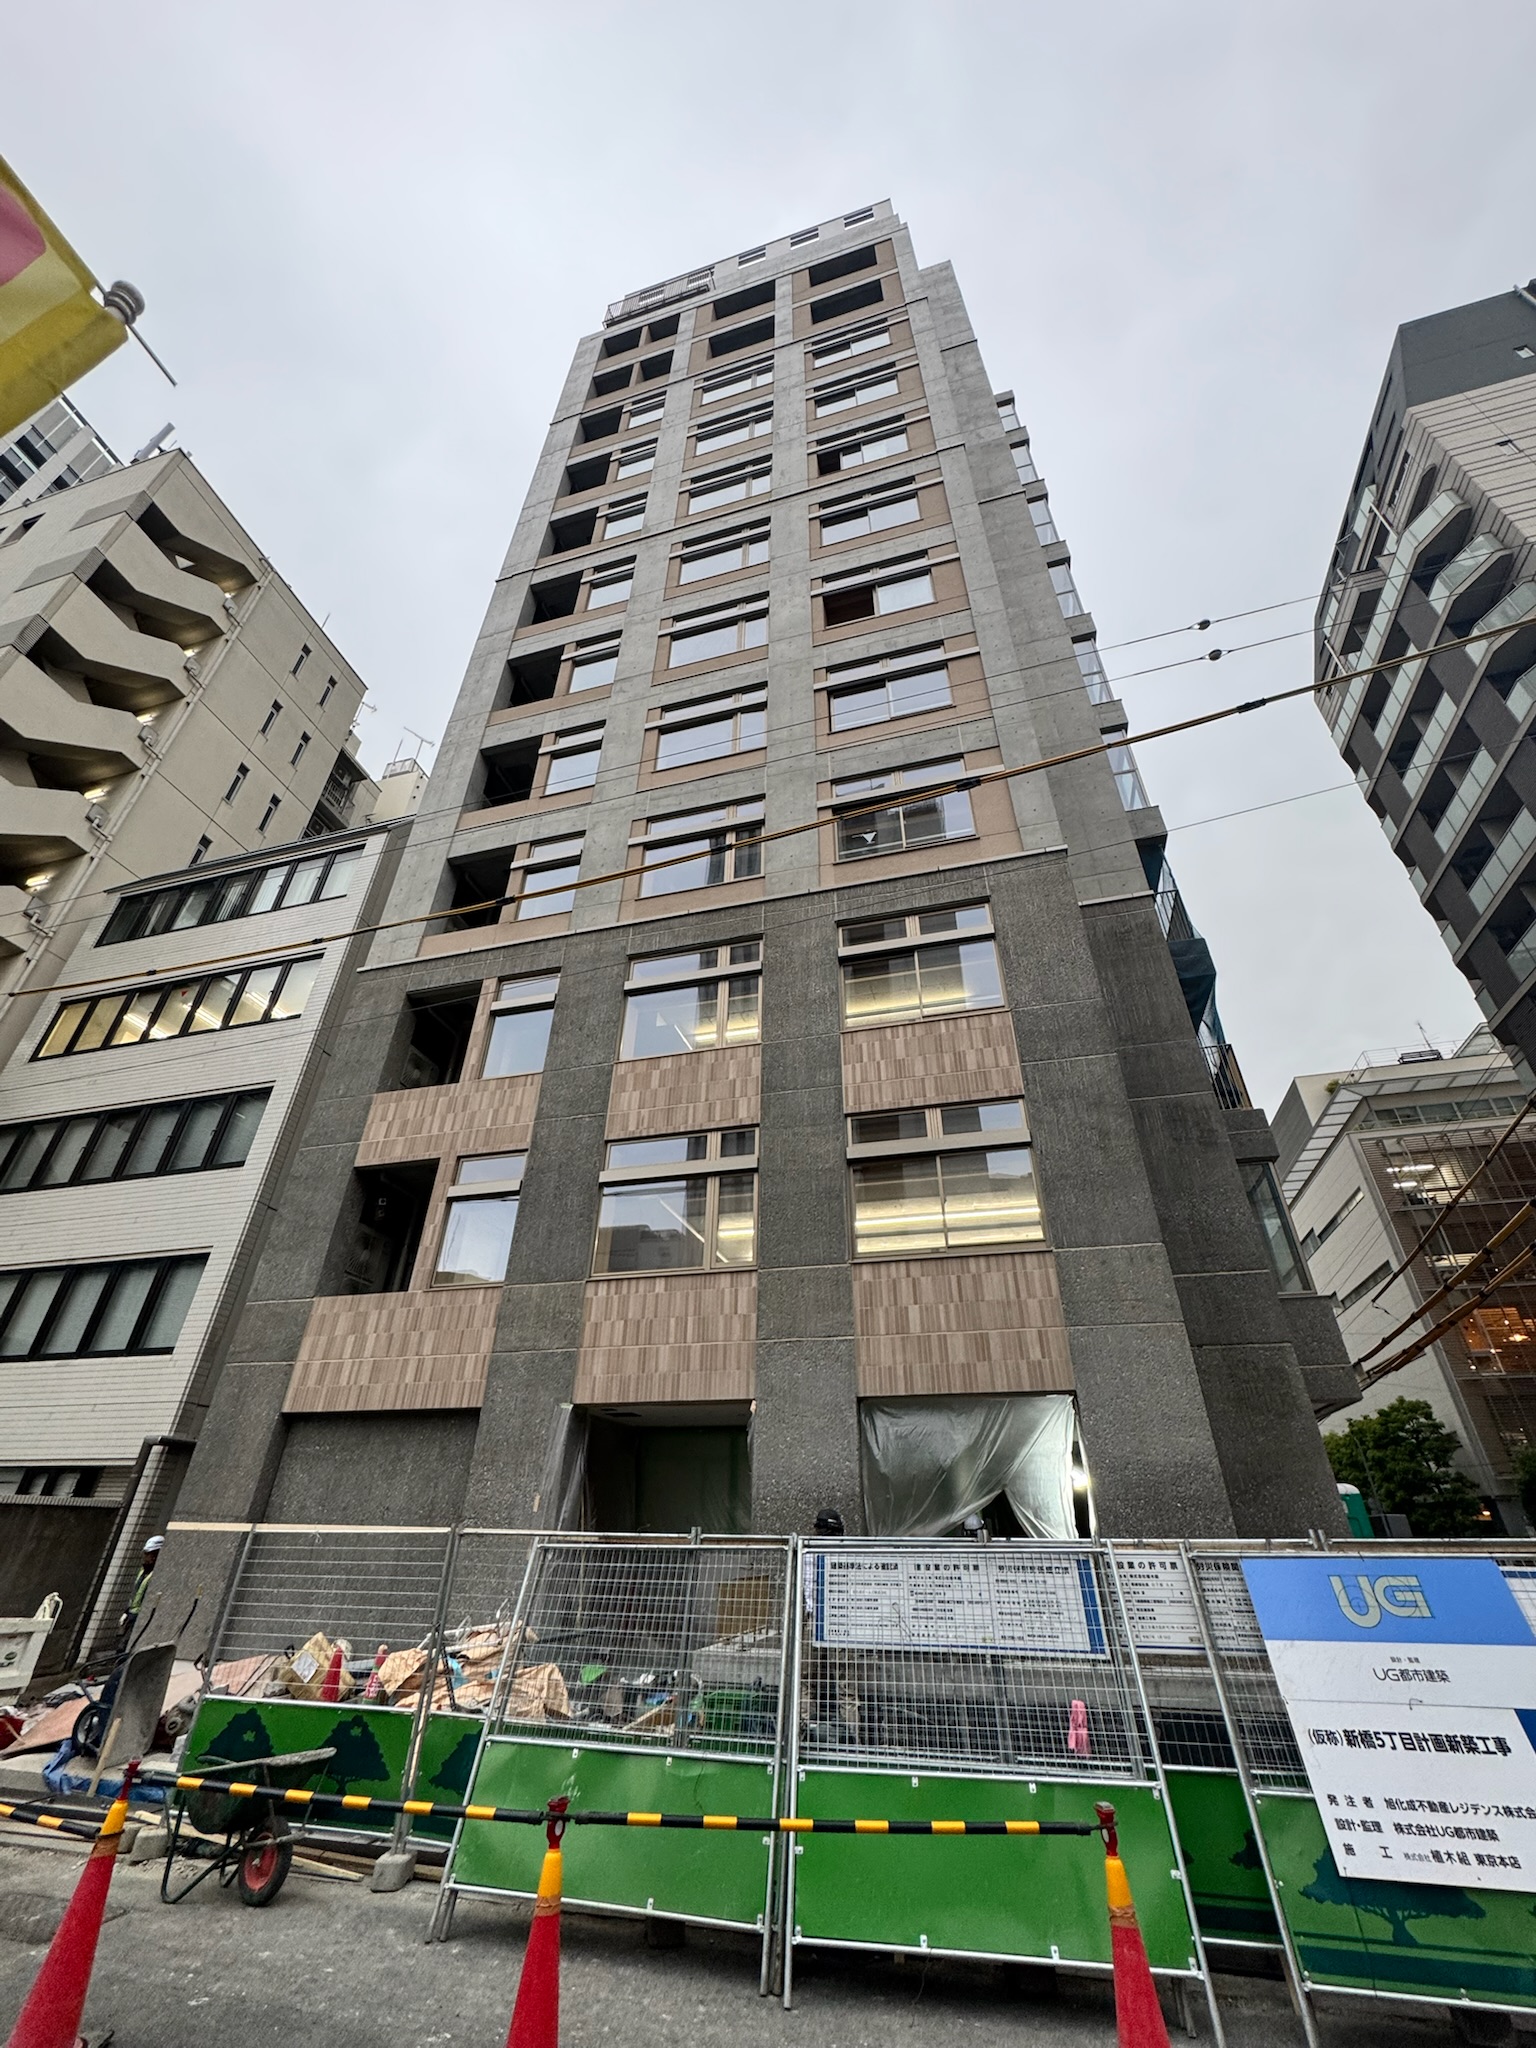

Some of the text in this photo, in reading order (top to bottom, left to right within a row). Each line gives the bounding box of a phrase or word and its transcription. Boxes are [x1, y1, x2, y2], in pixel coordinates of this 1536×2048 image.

[1327, 1574, 1435, 1629] UG
[1372, 1667, 1451, 1683] UG都市建築
[1327, 1793, 1374, 1809] 発注者
[1334, 1818, 1500, 1842] 設計・監理 株式会社UG都市建築
[1473, 1853, 1522, 1870] 東京本店
